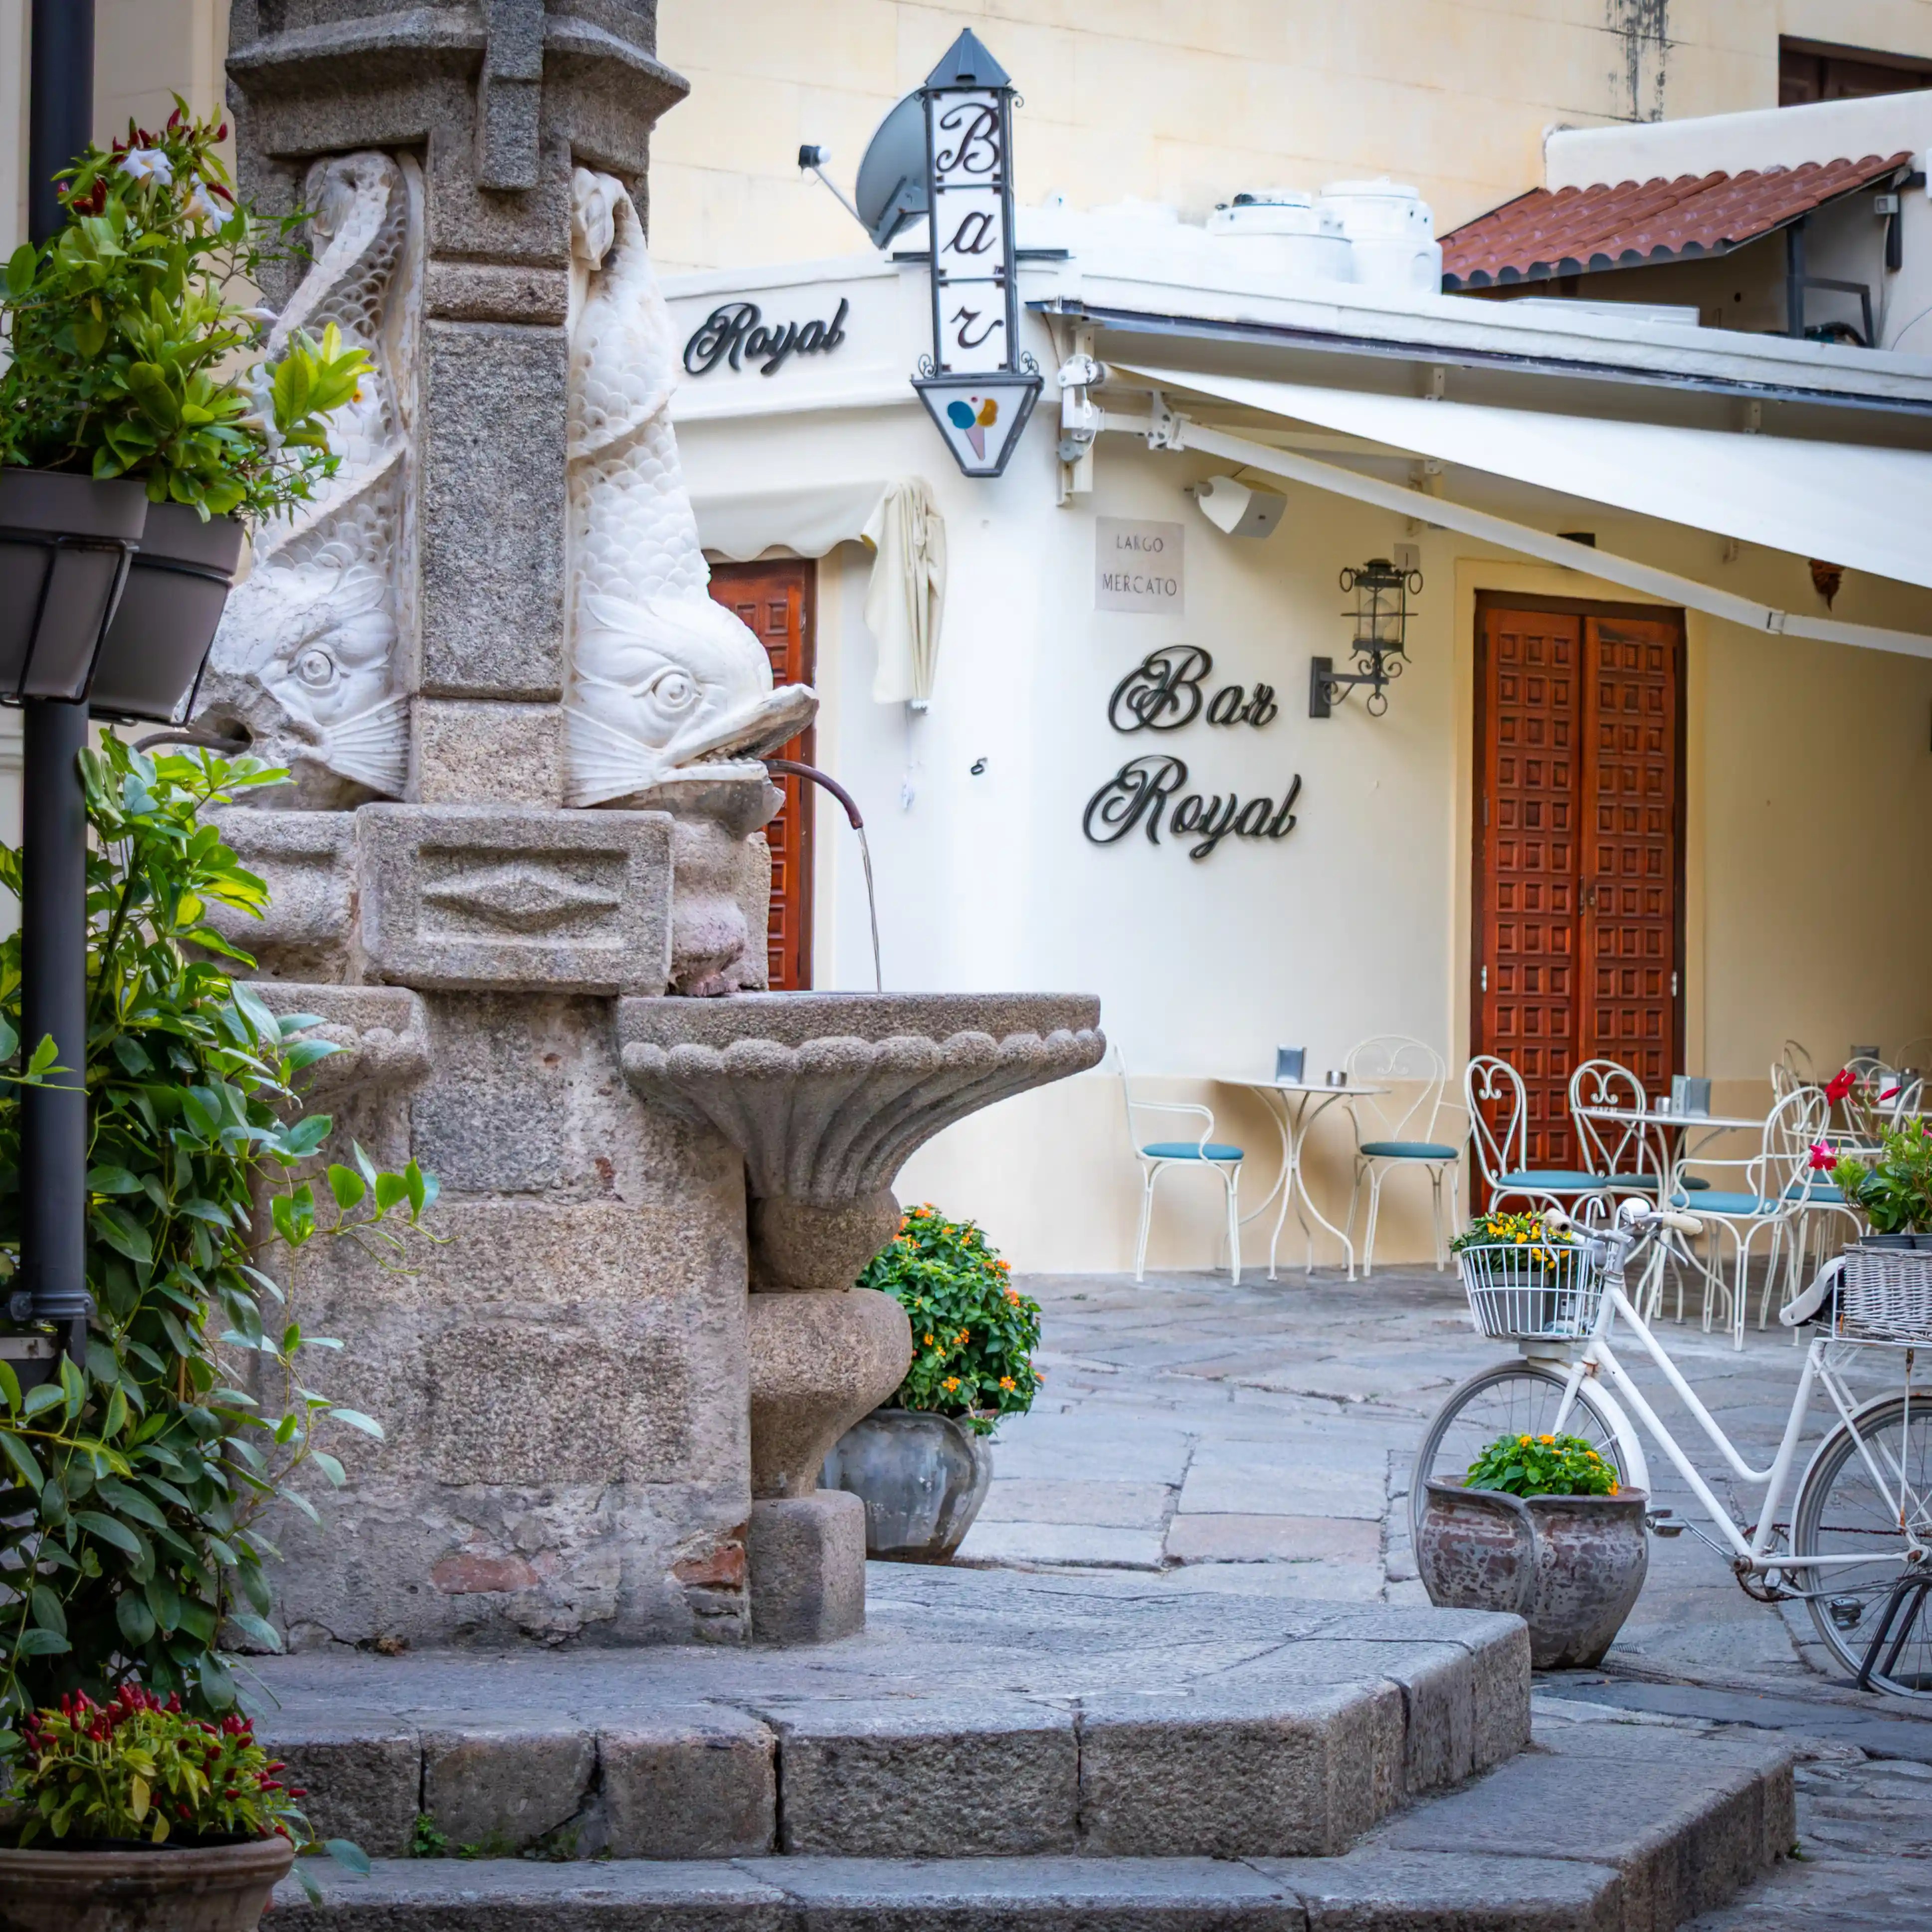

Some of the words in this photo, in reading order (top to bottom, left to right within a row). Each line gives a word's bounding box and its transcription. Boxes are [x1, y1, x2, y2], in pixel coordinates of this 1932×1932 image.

[936, 103, 1004, 349] Bar
[683, 297, 849, 377] Royal
[1103, 573, 1177, 596] MERCATO
[1117, 535, 1163, 553] LARGO
[1108, 645, 1278, 731] Bar
[1083, 755, 1302, 859] Royal
